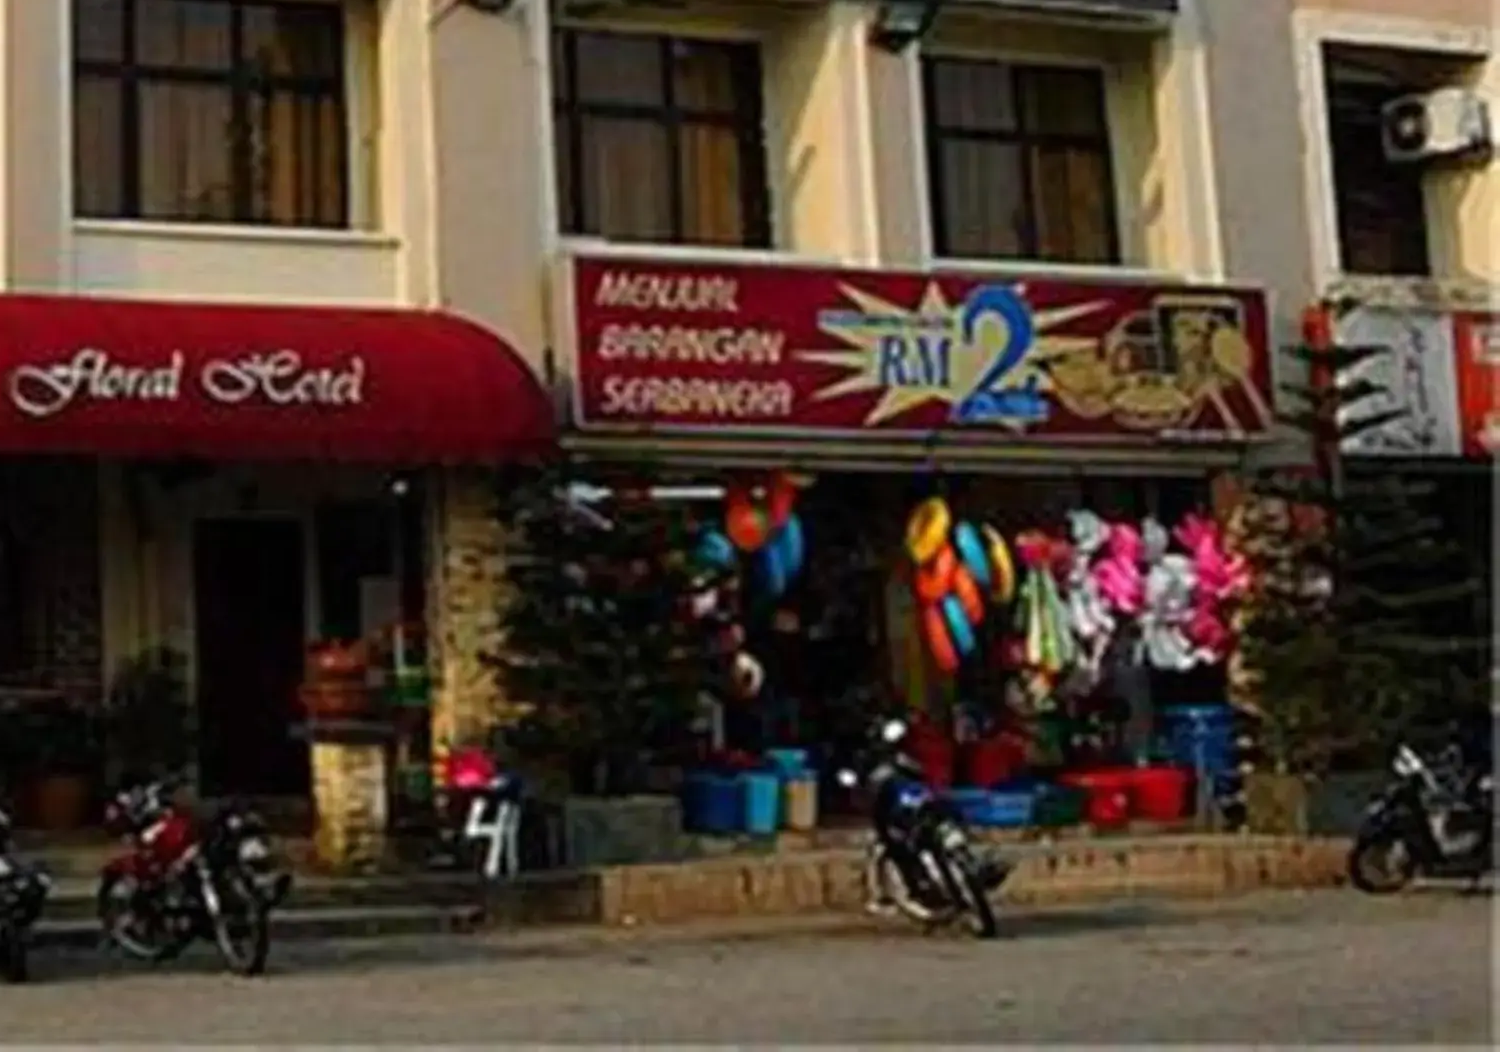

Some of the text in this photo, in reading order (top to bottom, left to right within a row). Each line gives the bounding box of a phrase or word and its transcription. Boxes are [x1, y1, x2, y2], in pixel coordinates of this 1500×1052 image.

[595, 271, 740, 313] MENJUAL
[598, 323, 787, 365] BARANGAN
[878, 334, 952, 387] RM
[956, 283, 1040, 420] 2
[8, 348, 364, 415] Floral Hotel
